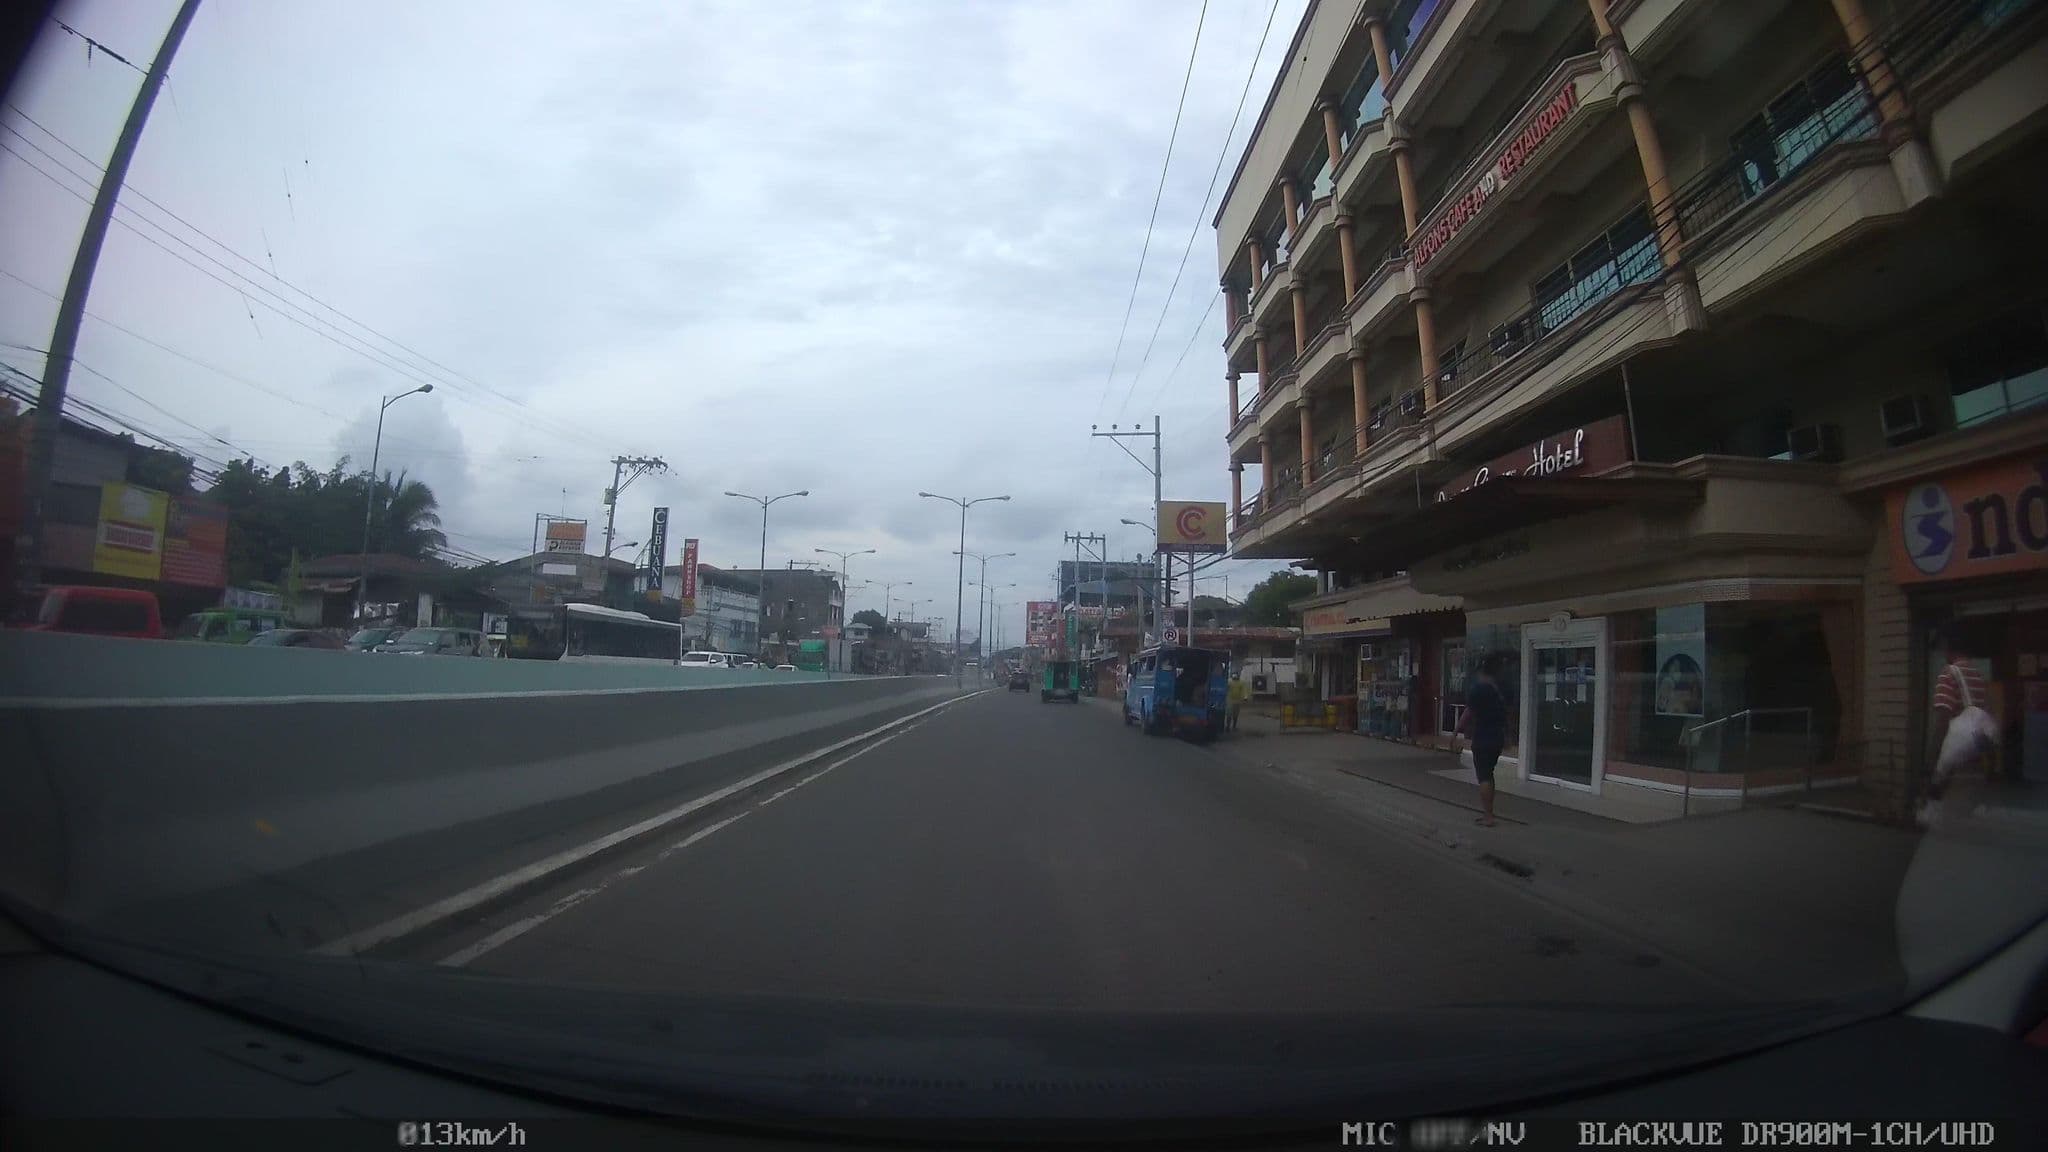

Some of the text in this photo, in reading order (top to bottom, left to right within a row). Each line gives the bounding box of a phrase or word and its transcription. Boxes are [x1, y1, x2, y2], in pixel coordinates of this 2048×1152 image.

[1447, 191, 1477, 232] CAFE
[1497, 82, 1580, 181] RESTAURANT
[1523, 427, 1584, 476] Hotel
[651, 510, 666, 587] CEBUANA
